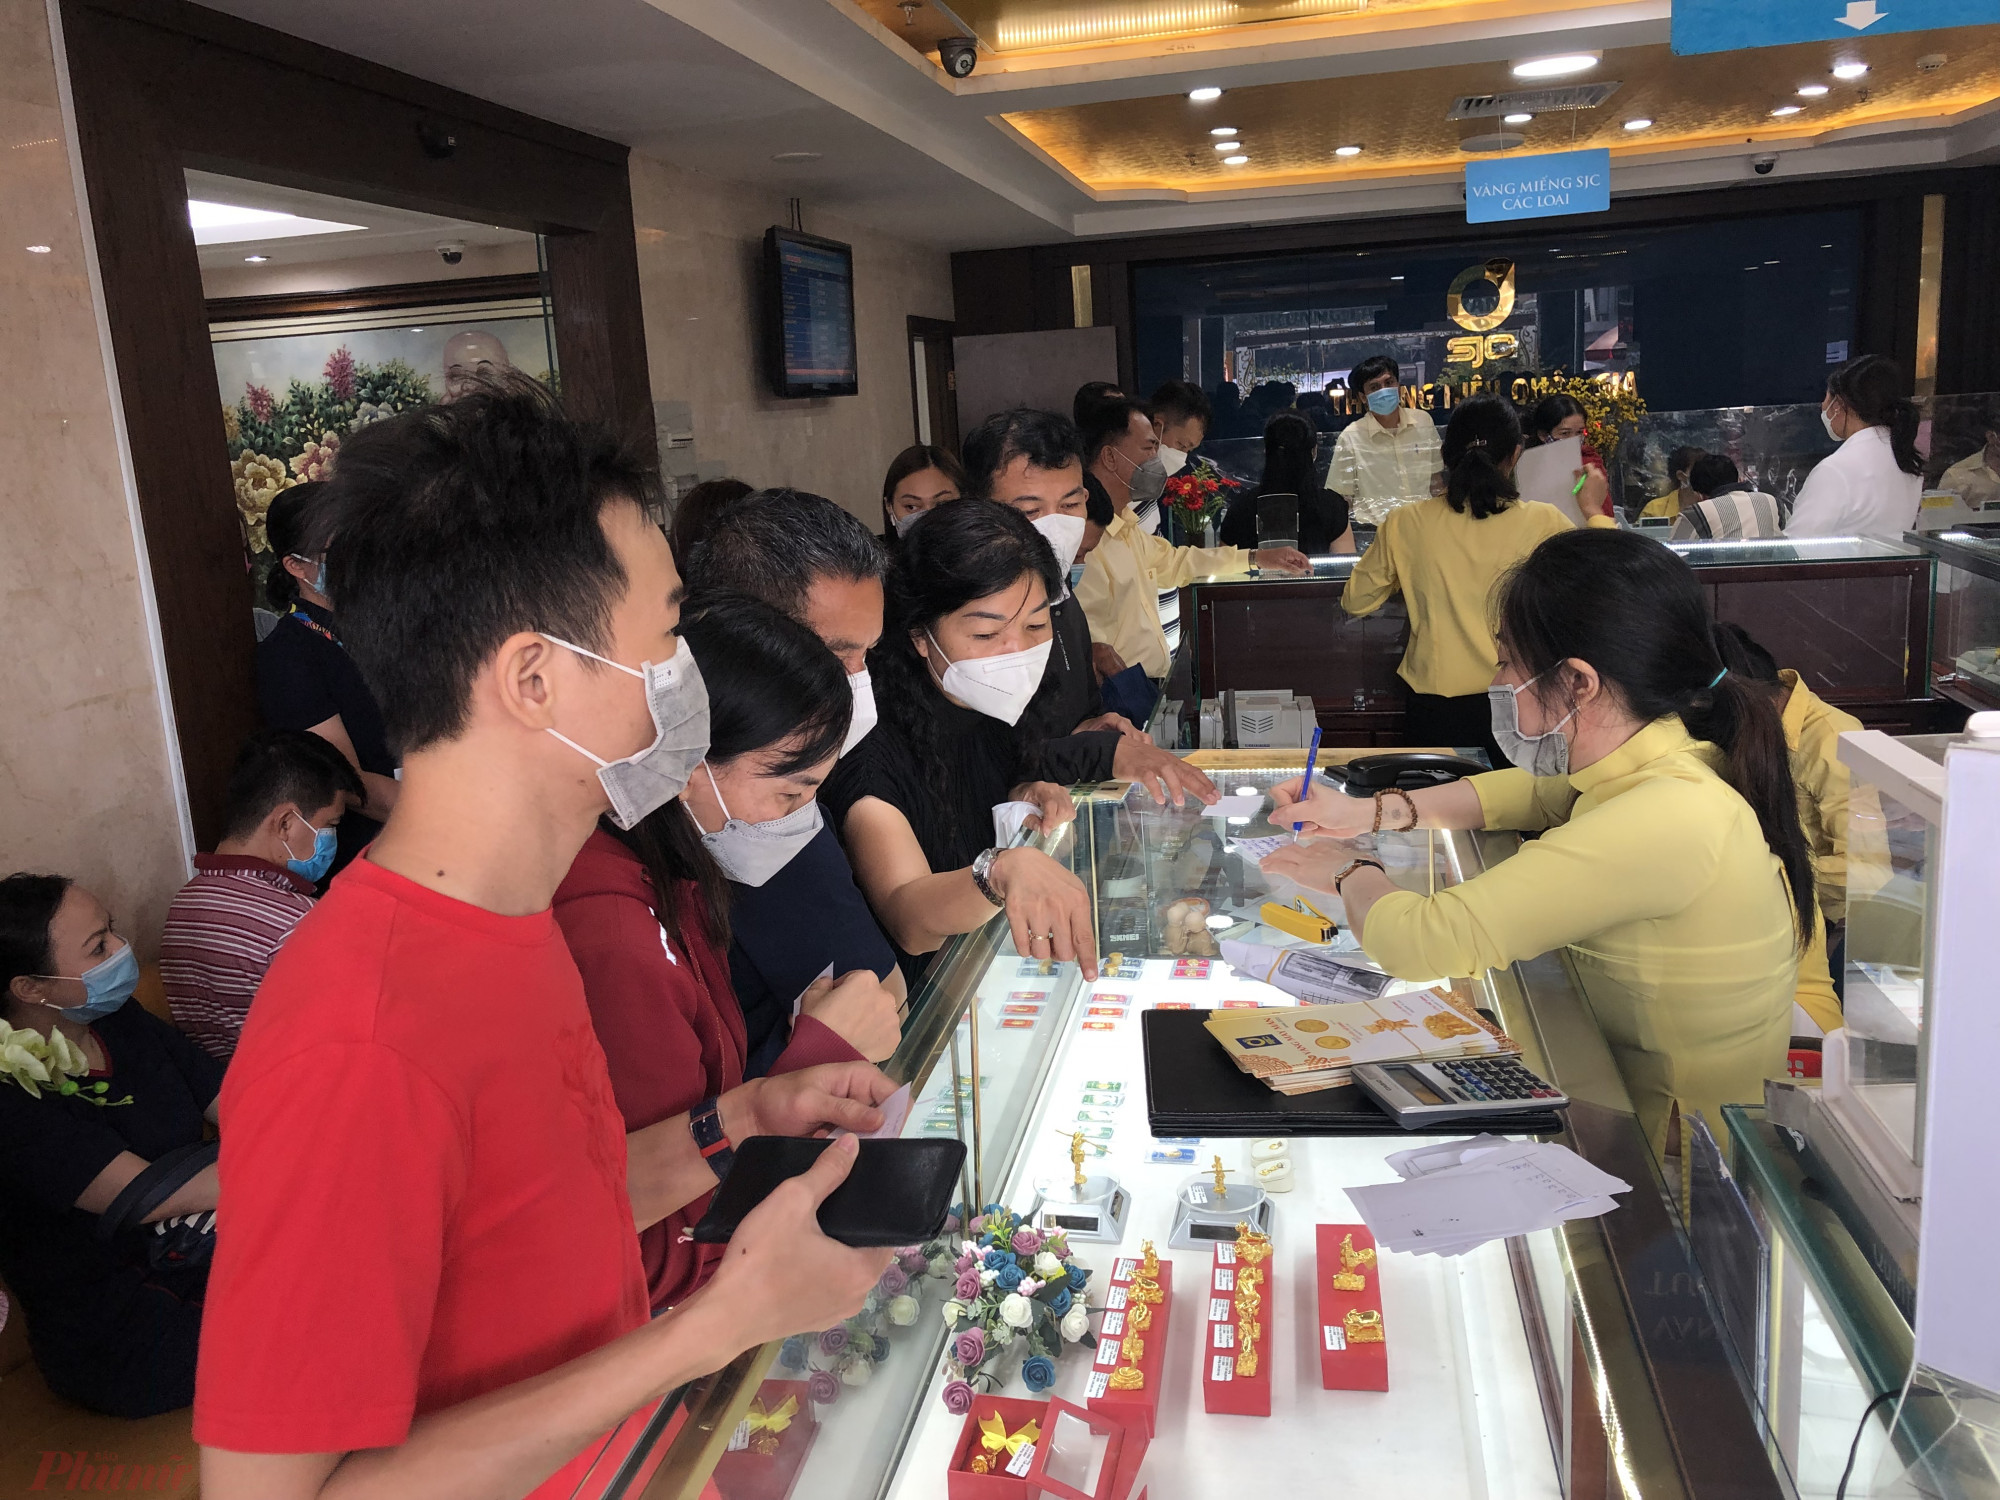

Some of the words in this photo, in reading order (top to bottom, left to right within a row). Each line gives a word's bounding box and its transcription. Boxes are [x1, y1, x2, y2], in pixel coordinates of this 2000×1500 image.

[1472, 182, 1516, 198] VÀNG
[1519, 174, 1572, 194] MIẾNG
[1576, 174, 1601, 189] SJC
[1501, 194, 1533, 211] CÁC
[1537, 192, 1570, 208] LOẠI
[1329, 383, 1435, 416] THNG
